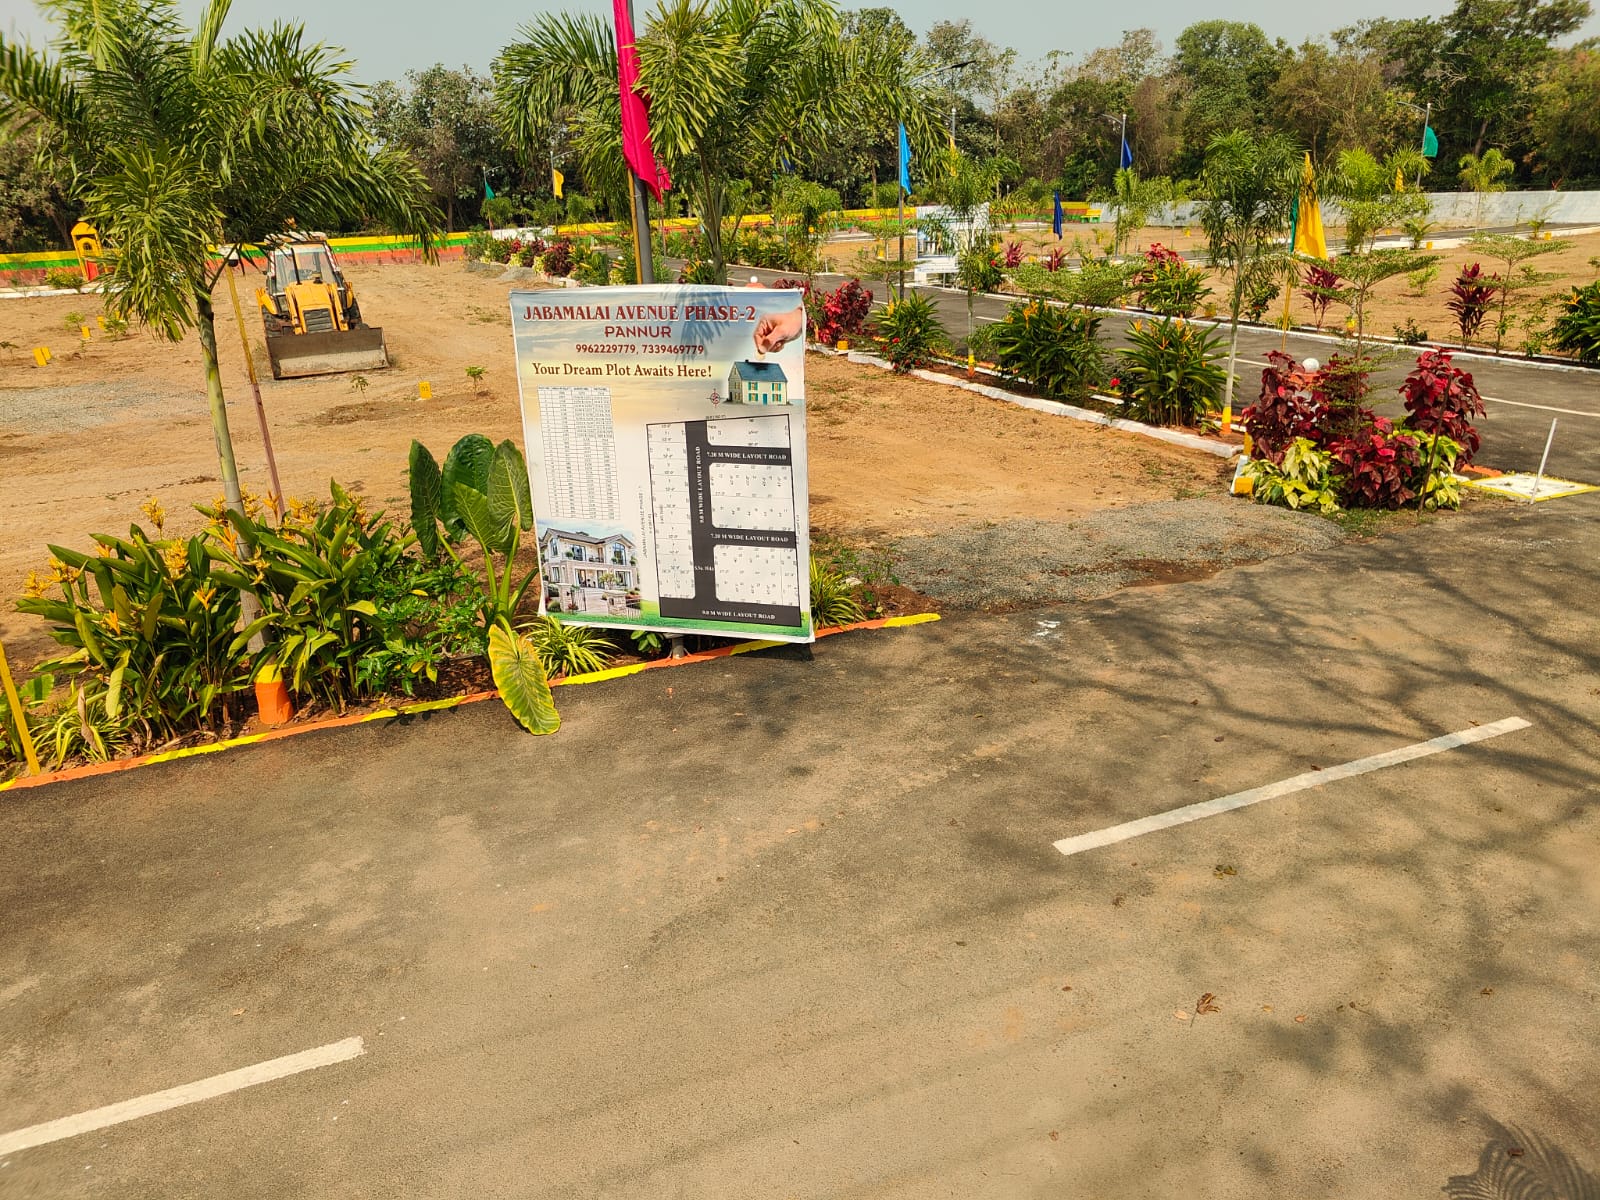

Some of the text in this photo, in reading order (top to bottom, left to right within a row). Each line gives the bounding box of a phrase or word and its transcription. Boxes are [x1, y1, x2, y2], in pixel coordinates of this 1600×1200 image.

[524, 305, 756, 320] JABAMALAI AVENUE PHASE-2
[605, 326, 671, 338] PANNUR
[575, 344, 704, 355] 9962229779, 7339469779
[532, 362, 712, 377] Your Dream Plot Awaits Here!
